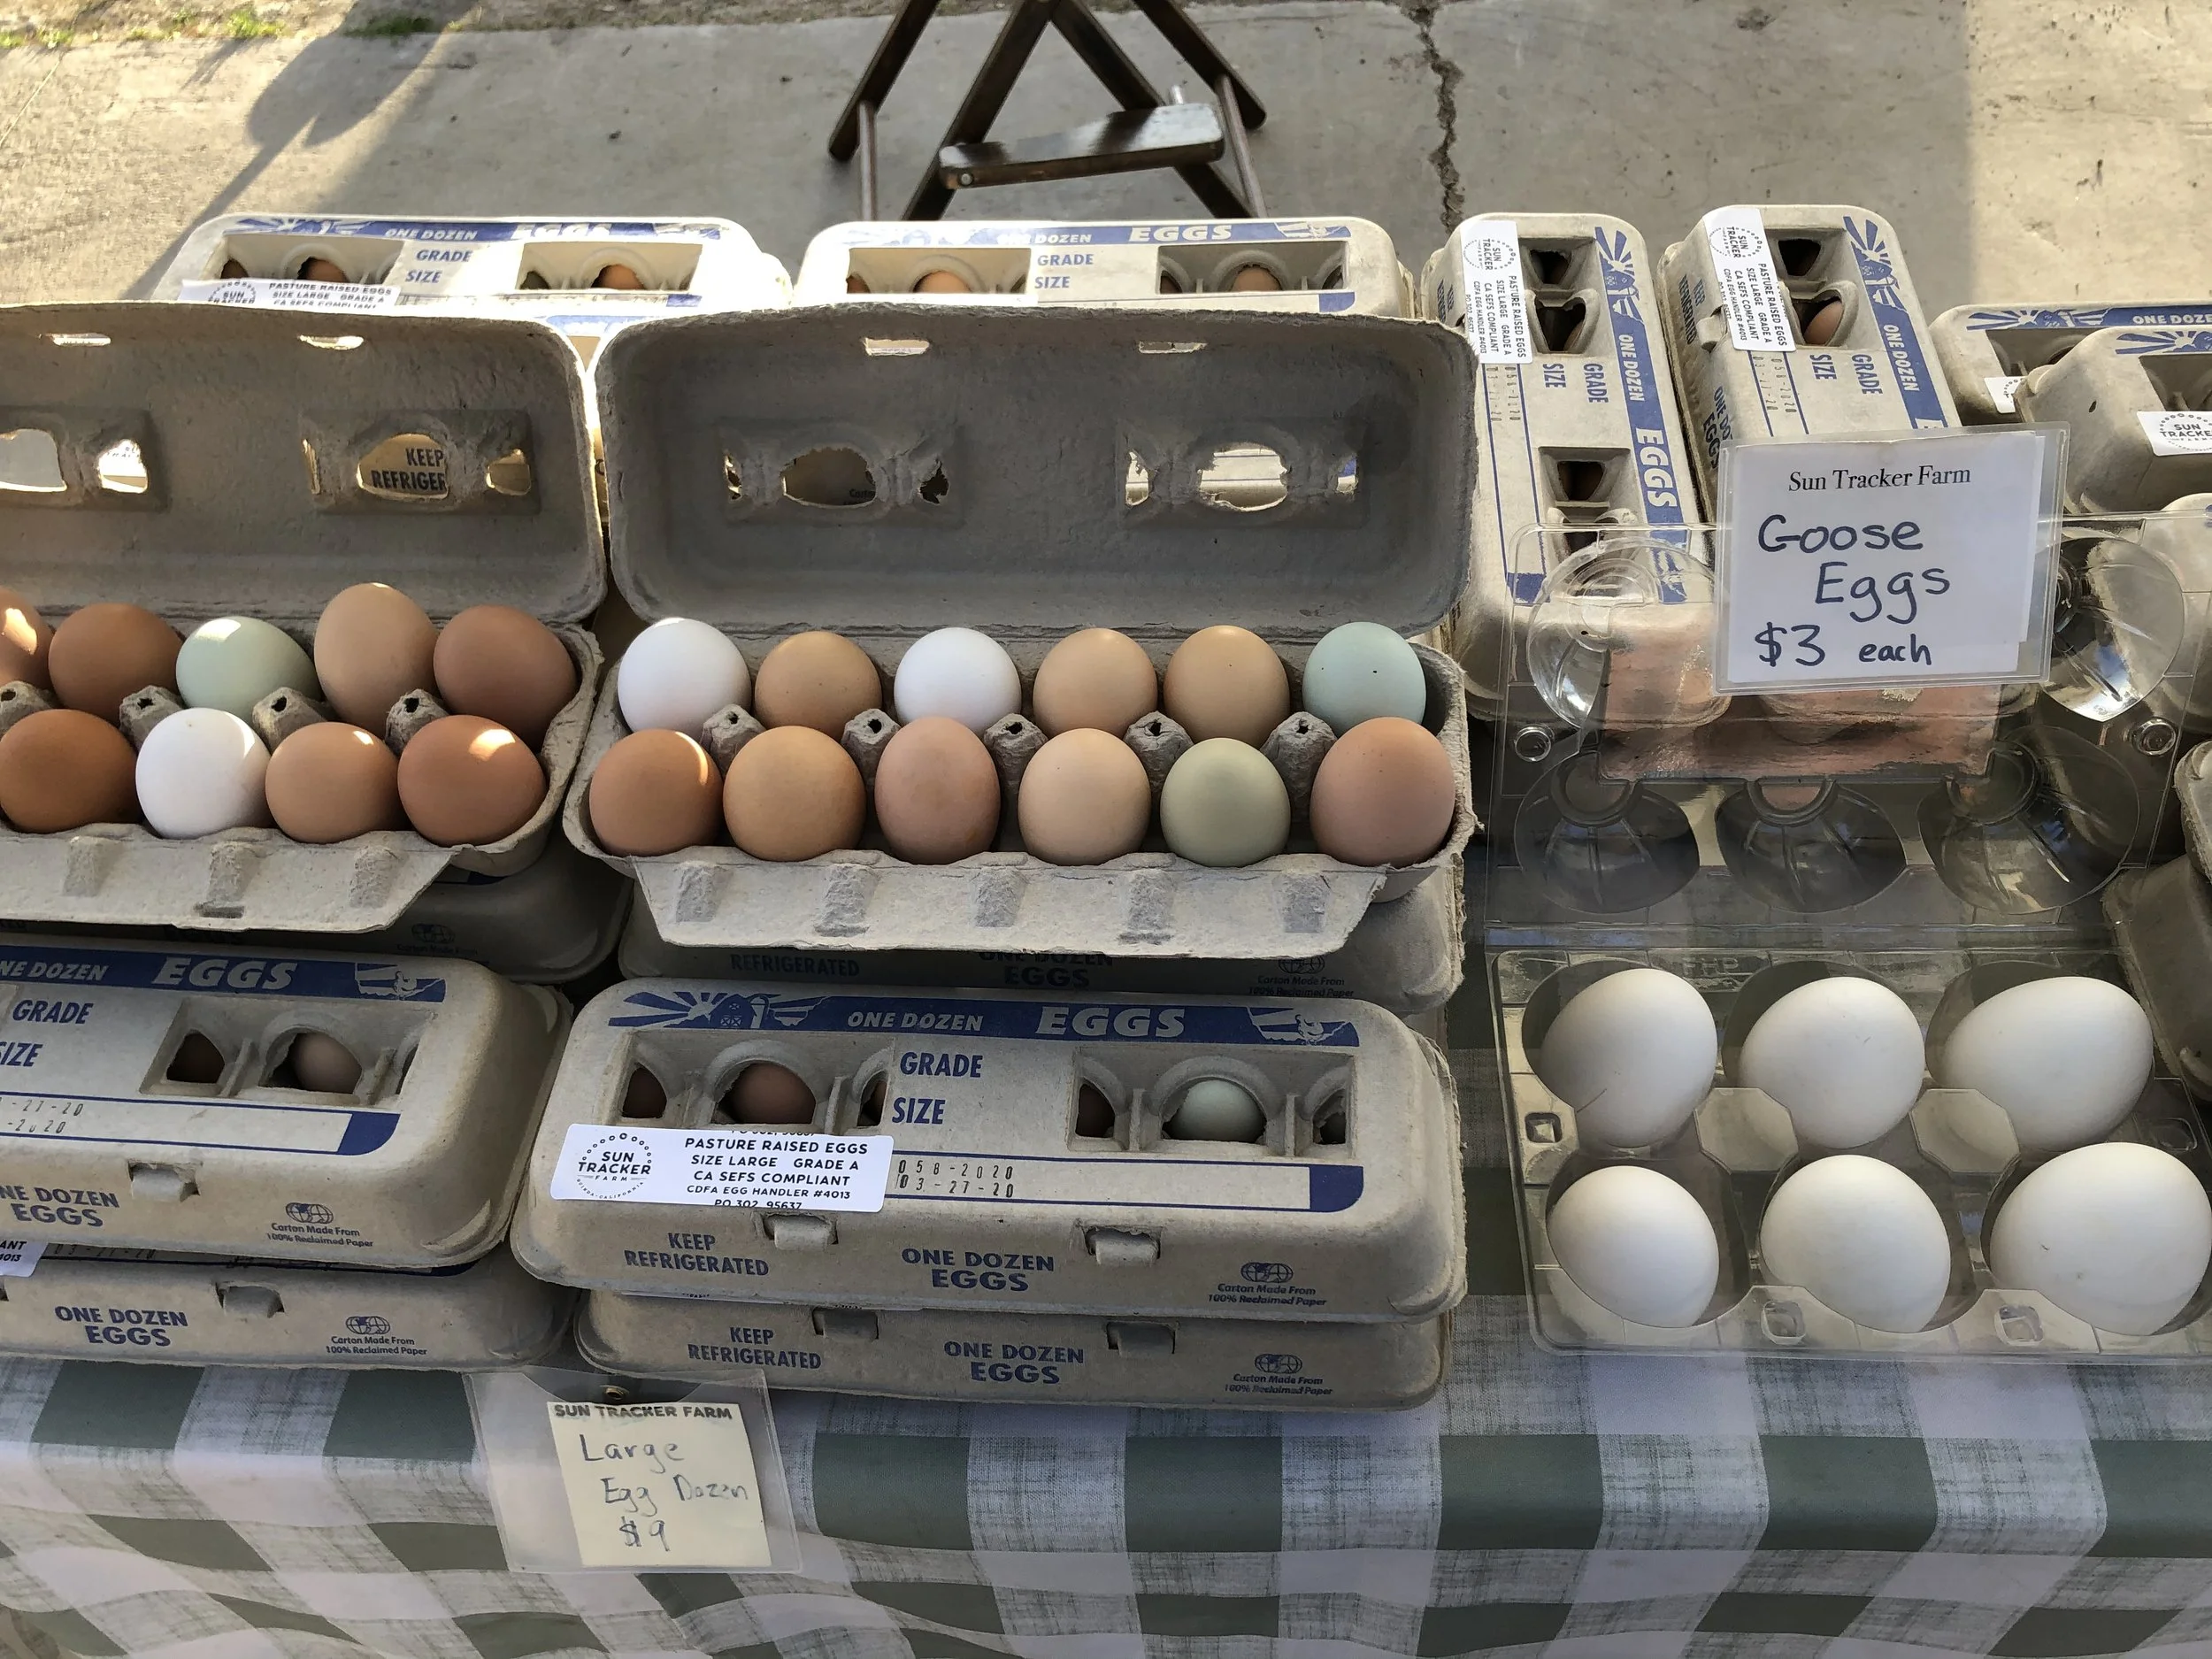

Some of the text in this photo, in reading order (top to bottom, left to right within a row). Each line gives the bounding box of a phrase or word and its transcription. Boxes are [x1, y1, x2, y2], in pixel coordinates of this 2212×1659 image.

[384, 227, 477, 241] ONE DOZEN
[1033, 225, 1232, 244] DOZEN EGGS
[1726, 227, 1741, 258] TRACKER
[1739, 235, 1748, 250] SUN
[416, 250, 473, 263] GRADE
[1037, 254, 1094, 266] GRADE
[1482, 238, 1494, 271] TRACKER
[1492, 247, 1502, 262] SUN
[405, 269, 441, 283] SIZE
[1034, 276, 1071, 289] SIZE
[1724, 268, 1732, 282] CDFA
[269, 282, 392, 296] PASTURE RAISED EGGS
[1726, 283, 1735, 295] EGG
[1498, 296, 1508, 319] LARGE
[1731, 296, 1742, 323] HANDLER
[1734, 271, 1759, 340] CA SEFS COMPLIANT
[1747, 268, 1770, 336] SIZE LARGE GRADE
[1758, 264, 1772, 295] PASTURE
[1768, 296, 1780, 323] RAISED
[1775, 326, 1787, 346] EGGS
[1476, 307, 1485, 335] HANDLER
[1484, 282, 1499, 353] CA SEFS COMPLIANT
[1509, 275, 1526, 357] PASTURE RAISED EGGS
[2132, 315, 2167, 325] ONE
[1502, 325, 1511, 349] GRADE
[1738, 324, 1747, 342] #4013
[1809, 355, 1837, 380] SIZE
[1884, 324, 1919, 391] ONE DOZEN
[1542, 364, 1566, 388] SIZE
[1584, 364, 1608, 403] GRADE
[1851, 354, 1883, 395] GRADE
[1618, 334, 1678, 508] ONE DOZEN EGGS
[405, 448, 444, 467] KEEP
[1788, 465, 1971, 492] Sun Tracker Farm
[1758, 514, 1924, 553] Goose
[1815, 561, 1950, 625] Eggs
[1755, 621, 1932, 666] $3 each
[0, 956, 298, 991] NE DOZEN EGGS
[730, 953, 860, 977] REFRIGERATED
[1003, 965, 1090, 988] EGGS
[1257, 975, 1289, 985] Carton
[1320, 977, 1345, 986] From
[1326, 988, 1355, 998] Paper
[12, 1000, 94, 1025] GRADE
[847, 1007, 1187, 1038] ONE DOZEN EGGS
[900, 1051, 984, 1079] GRADE
[892, 1096, 946, 1125] SIZE
[602, 1151, 634, 1163] SUN
[685, 1138, 868, 1155] PASTURE RAISED EGGS
[578, 1162, 651, 1175] TRACKER
[691, 1155, 859, 1171] SIZE LARGE GRADE A
[899, 1159, 1013, 1179] 058-2020
[694, 1171, 850, 1187] CA SEFS COMPLIANT
[35, 1187, 120, 1209] DOZEN
[687, 1185, 850, 1199] CDFA EGG HANDLER #4013
[11, 1203, 104, 1227] EGGS
[766, 1201, 802, 1210] 95637
[267, 1233, 373, 1248] 100% Reclaimed Paper
[271, 1223, 360, 1237] Carton Made From
[667, 1232, 716, 1251] KEEP
[624, 1250, 769, 1277] REFRIGERATED
[902, 1248, 1055, 1271] ONE DOZEN
[931, 1269, 1029, 1292] EGGS
[1217, 1283, 1316, 1295] Carton Made From
[1208, 1294, 1326, 1308] 100% Reclaimed Paper
[54, 1306, 188, 1327] ONE DOZEN
[85, 1325, 171, 1347] EGGS
[729, 1327, 774, 1346] KEEP
[353, 1346, 399, 1355] Reclaimed
[401, 1347, 427, 1356] Paper
[687, 1344, 821, 1370] REFRIGERATED
[943, 1340, 1084, 1363] ONE DOZEN
[971, 1361, 1060, 1385] EGGS
[1233, 1373, 1266, 1383] Carton
[1268, 1375, 1295, 1384] Made
[1225, 1384, 1333, 1396] 100% Reclaimed Paper
[554, 1404, 733, 1419] SUN TRACKER FARM
[580, 1433, 685, 1473] Large
[601, 1474, 748, 1517] Egg Dozen
[619, 1516, 670, 1552] $9
